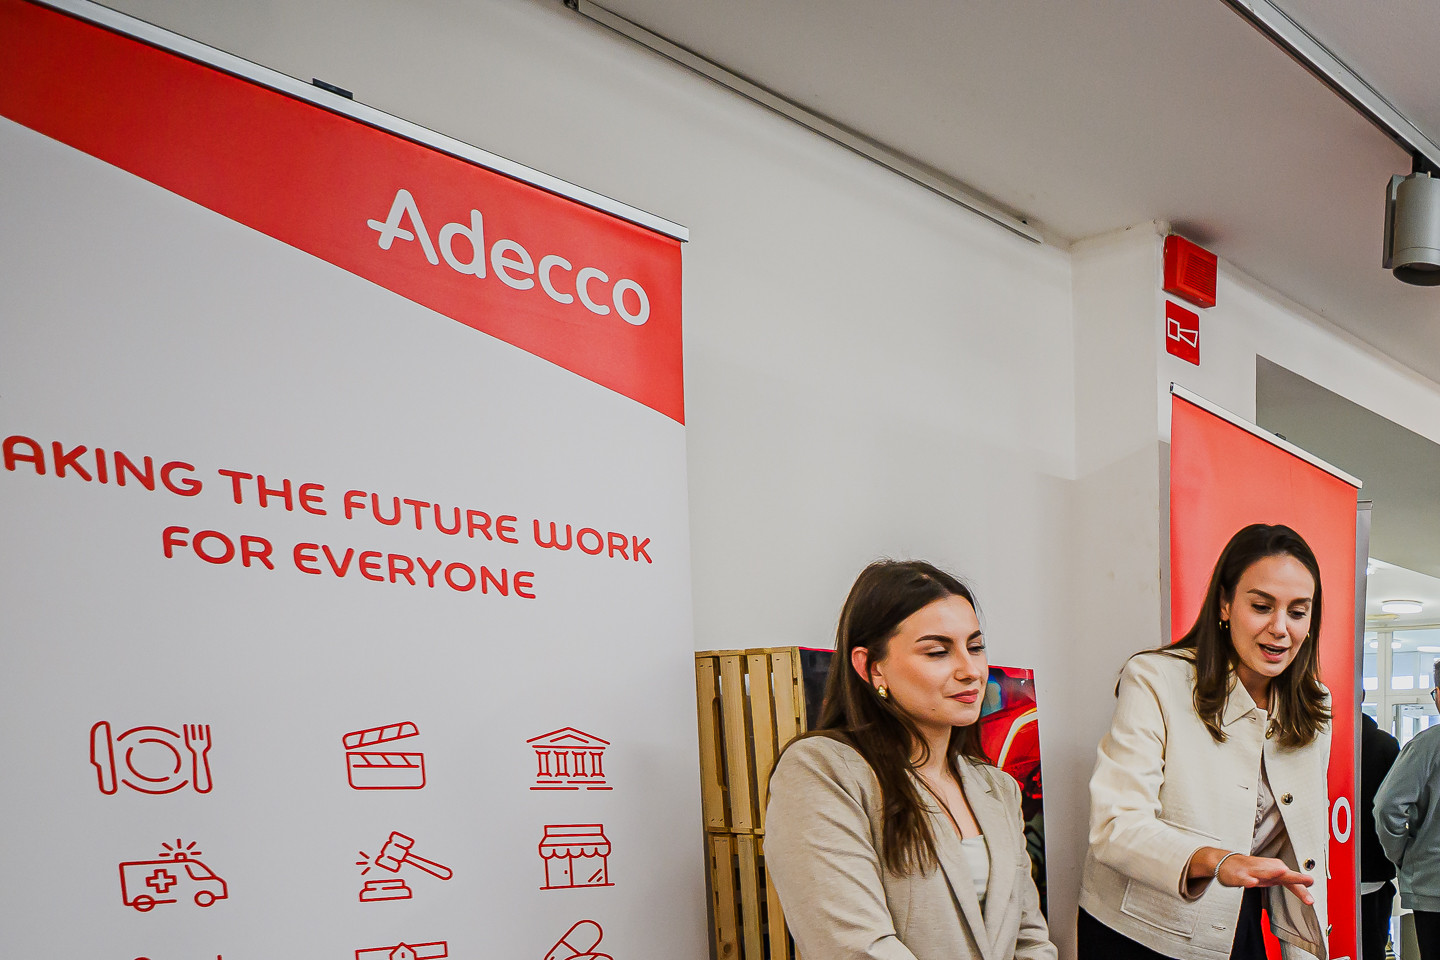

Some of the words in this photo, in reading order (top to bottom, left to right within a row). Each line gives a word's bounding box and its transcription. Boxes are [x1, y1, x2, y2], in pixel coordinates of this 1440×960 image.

[366, 188, 651, 326] Adecco
[1, 434, 203, 498] AKING
[218, 468, 327, 516] THE
[343, 489, 519, 545] FUTURE
[532, 518, 653, 564] WORK
[161, 525, 275, 571] FOR
[293, 542, 536, 600] EVERYONE
